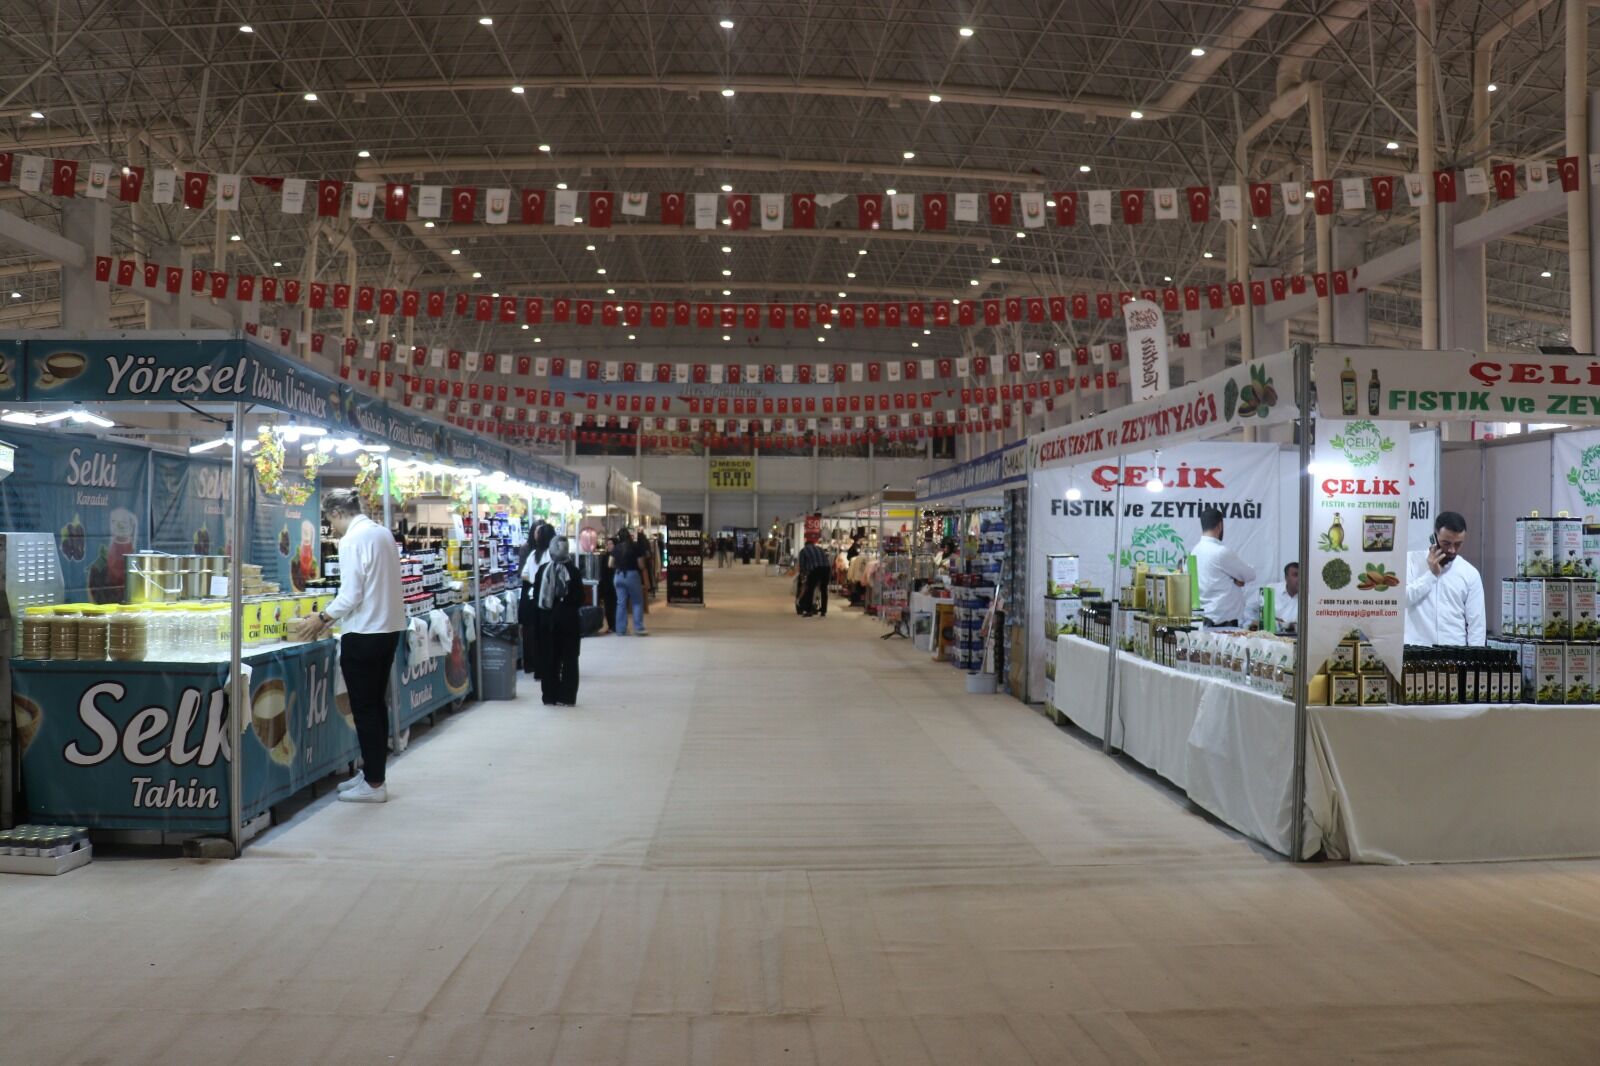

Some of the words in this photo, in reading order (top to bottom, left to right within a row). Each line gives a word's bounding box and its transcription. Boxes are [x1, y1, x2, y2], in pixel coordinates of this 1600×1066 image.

[105, 353, 247, 395] Yöresel
[1388, 390, 1490, 411] FISTIK
[1500, 396, 1535, 413] ve
[1107, 429, 1118, 443] ve
[1346, 436, 1376, 449] ÇELİK
[67, 447, 117, 488] Selki
[1091, 462, 1225, 492] ÇELİK
[1322, 476, 1401, 498] ÇELİK
[1051, 499, 1115, 517] FISTIK
[1124, 502, 1144, 518] ve
[64, 682, 232, 766] Selk
[131, 777, 219, 809] Tahin
